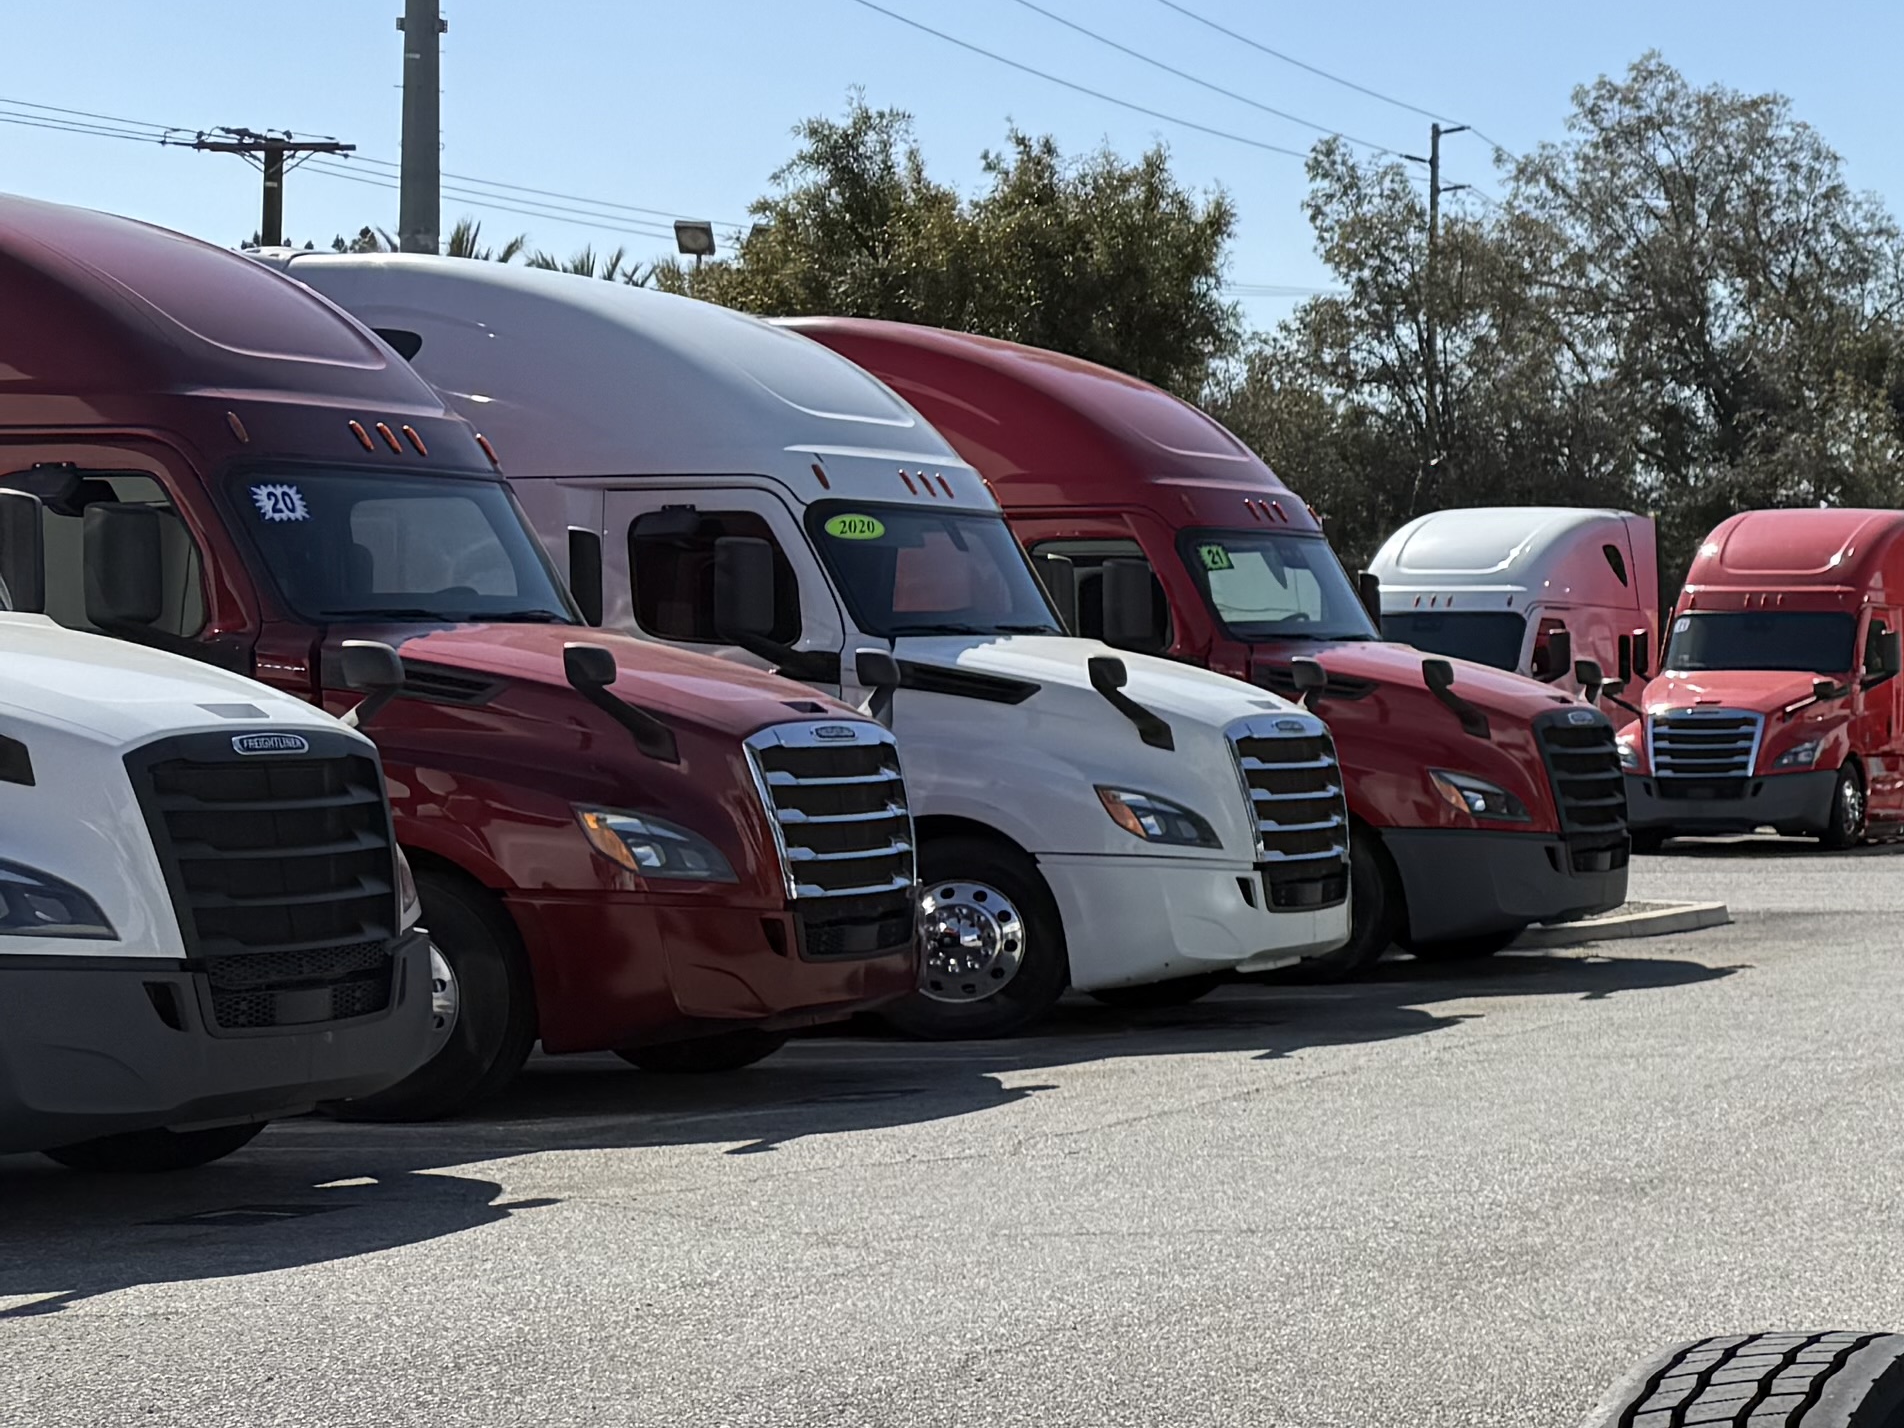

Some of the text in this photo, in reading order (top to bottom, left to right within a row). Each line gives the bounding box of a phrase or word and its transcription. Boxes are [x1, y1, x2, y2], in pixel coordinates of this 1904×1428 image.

[266, 490, 296, 514] 20
[838, 519, 876, 535] 2020
[1206, 548, 1225, 565] 21
